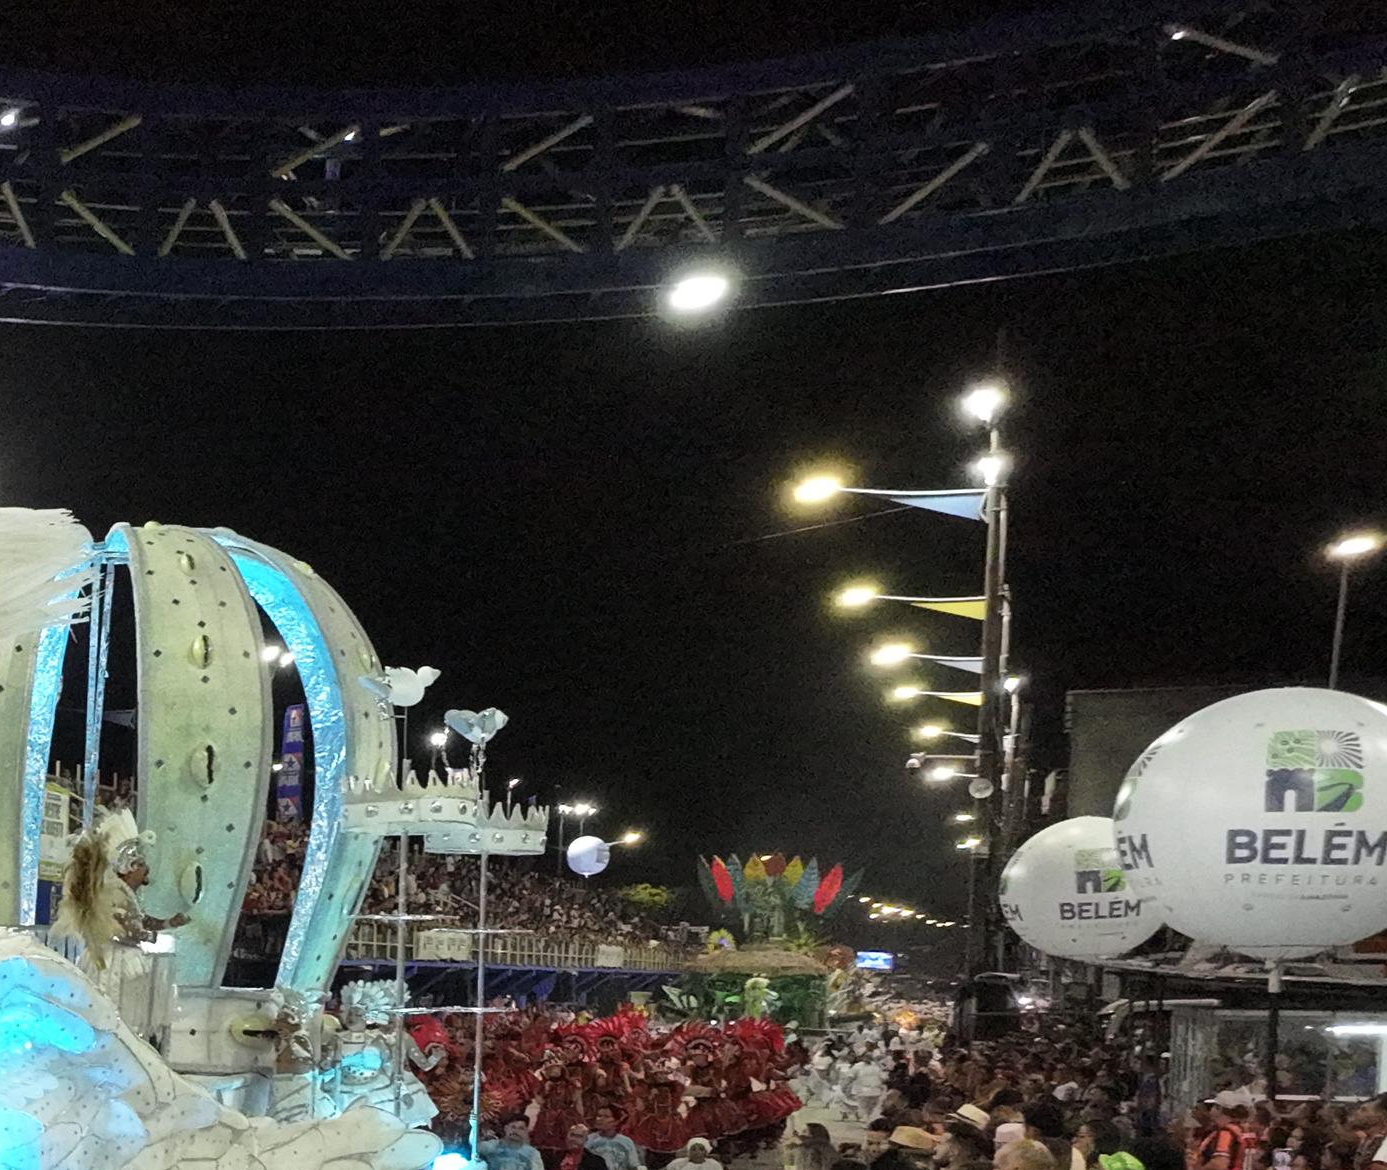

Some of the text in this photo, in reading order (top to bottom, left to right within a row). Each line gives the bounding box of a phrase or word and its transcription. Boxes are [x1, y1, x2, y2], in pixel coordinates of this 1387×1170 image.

[1227, 822, 1387, 866] BELÉM
[1224, 873, 1378, 887] PREFEITURA
[1059, 896, 1142, 920] BELÉM
